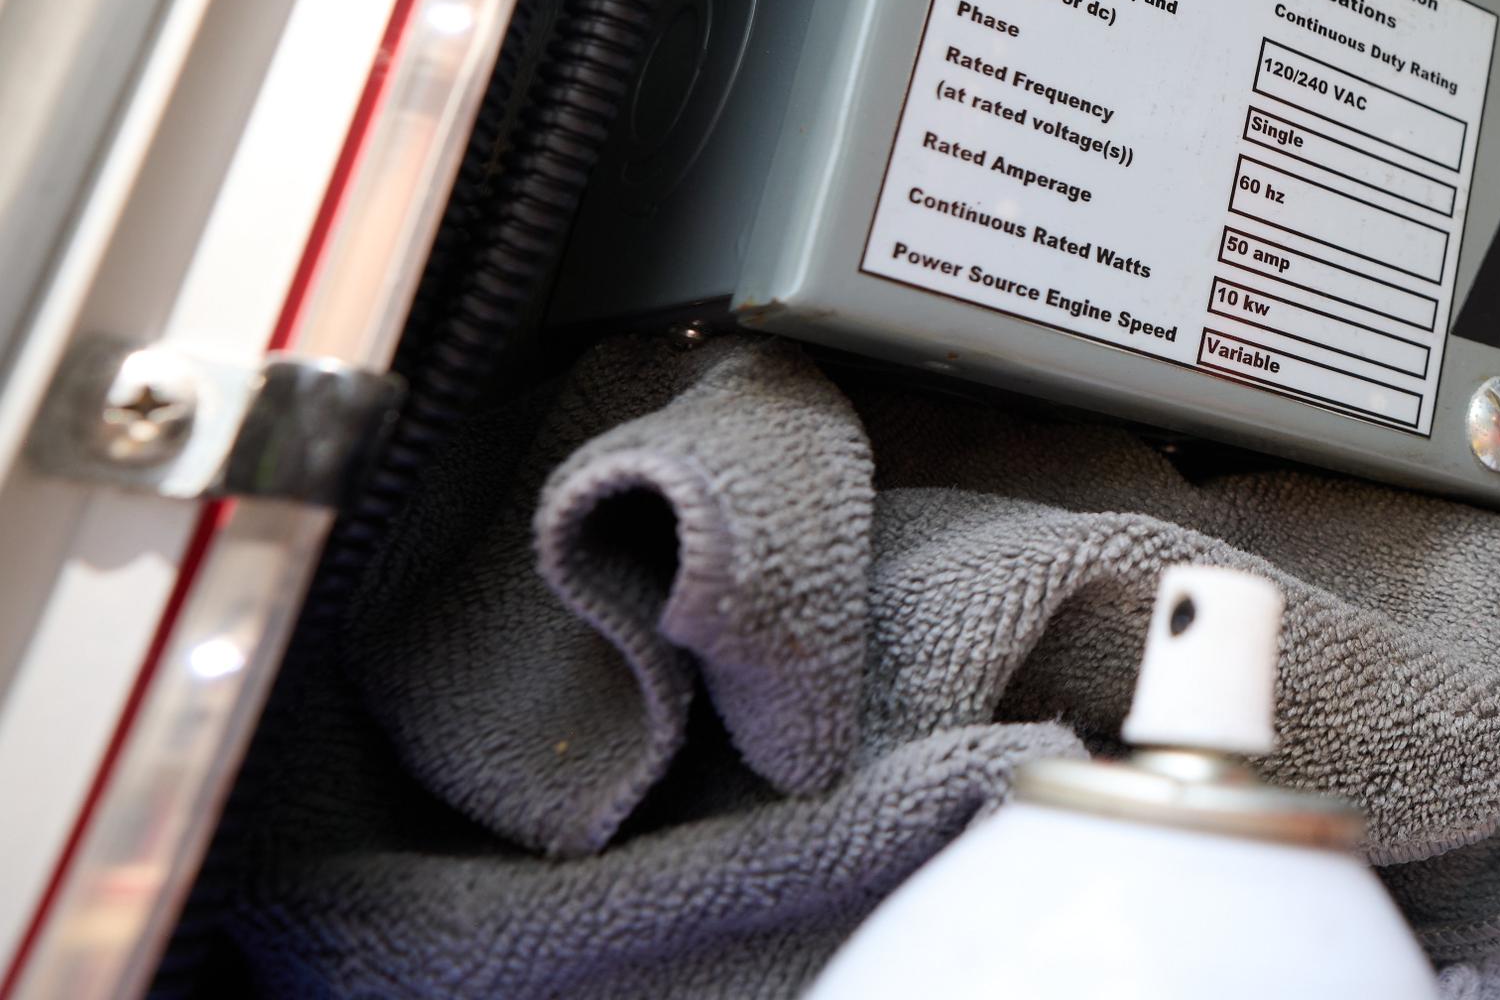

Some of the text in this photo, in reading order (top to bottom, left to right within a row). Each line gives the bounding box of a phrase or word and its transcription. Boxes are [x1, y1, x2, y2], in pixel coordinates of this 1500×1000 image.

[957, 0, 1020, 37] Phase
[1087, 1, 1116, 26] dc)
[1275, 3, 1458, 96] Continuous Duty Rating
[945, 46, 1115, 124] Rated Frequency
[1265, 58, 1367, 111] 120/240 VAC
[936, 80, 1133, 167] (at rated voltage(s))
[1251, 116, 1303, 147] Single
[922, 131, 1092, 202] Rated Amperage
[1240, 175, 1285, 204] 60 hz
[908, 187, 1151, 278] Continuous Rated Watts
[1227, 236, 1290, 273] 50 amp
[892, 241, 1178, 342] Power Source Engine Speed
[1218, 287, 1270, 316] 10 kw
[1207, 337, 1280, 373] Variable
